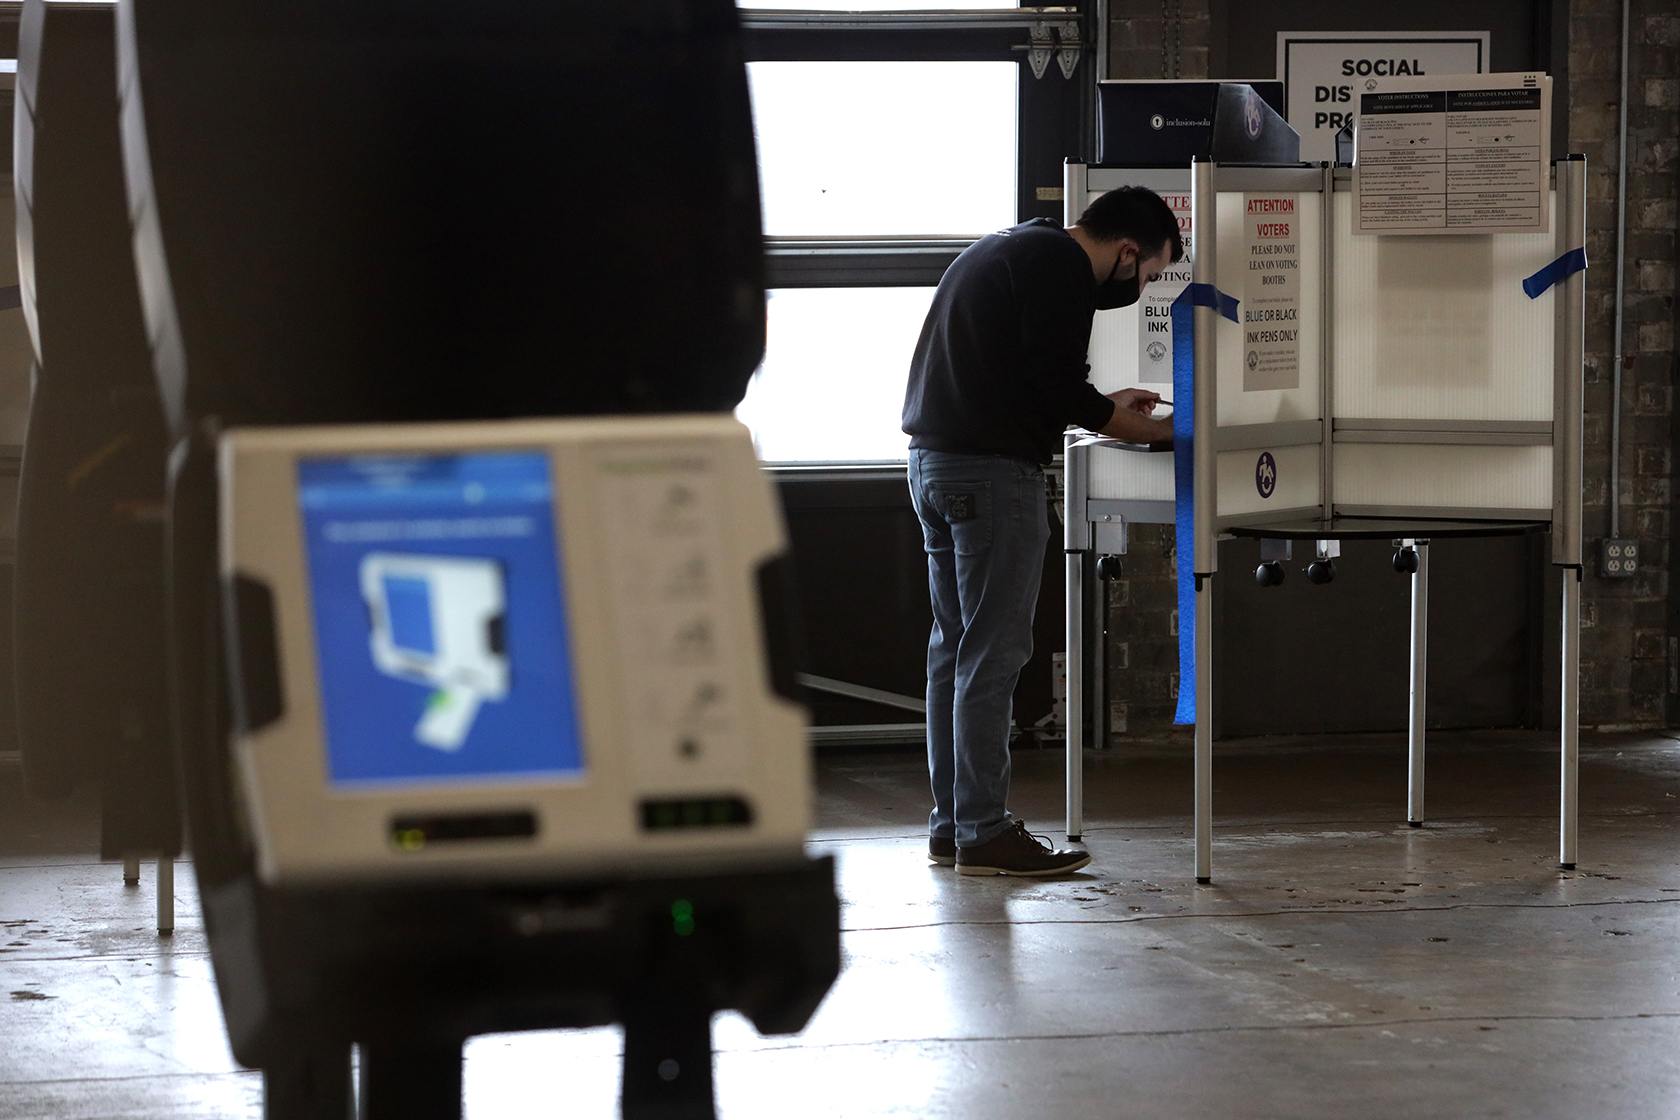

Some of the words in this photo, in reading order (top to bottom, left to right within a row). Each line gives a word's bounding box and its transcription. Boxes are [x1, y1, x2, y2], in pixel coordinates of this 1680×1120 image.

[1342, 59, 1425, 76] SOCIAL
[1315, 86, 1353, 102] DIS
[1247, 199, 1294, 213] ATTENTION
[1257, 223, 1290, 237] VOTERS
[1252, 245, 1273, 255] PLEASE
[1274, 244, 1282, 254] DO
[1284, 244, 1295, 254] NOT
[1249, 260, 1265, 270] LEAN
[1266, 260, 1274, 270] ON
[1275, 259, 1298, 270] VOTING
[1262, 275, 1286, 286] BOOTHS
[1145, 306, 1172, 317] BLU
[1245, 310, 1264, 322] BLUE
[1264, 310, 1274, 322] OR
[1275, 308, 1297, 321] BLACK
[1148, 322, 1168, 332] INK
[1247, 332, 1260, 344] INK
[1260, 330, 1278, 343] PENS
[1279, 330, 1298, 342] ONLY
